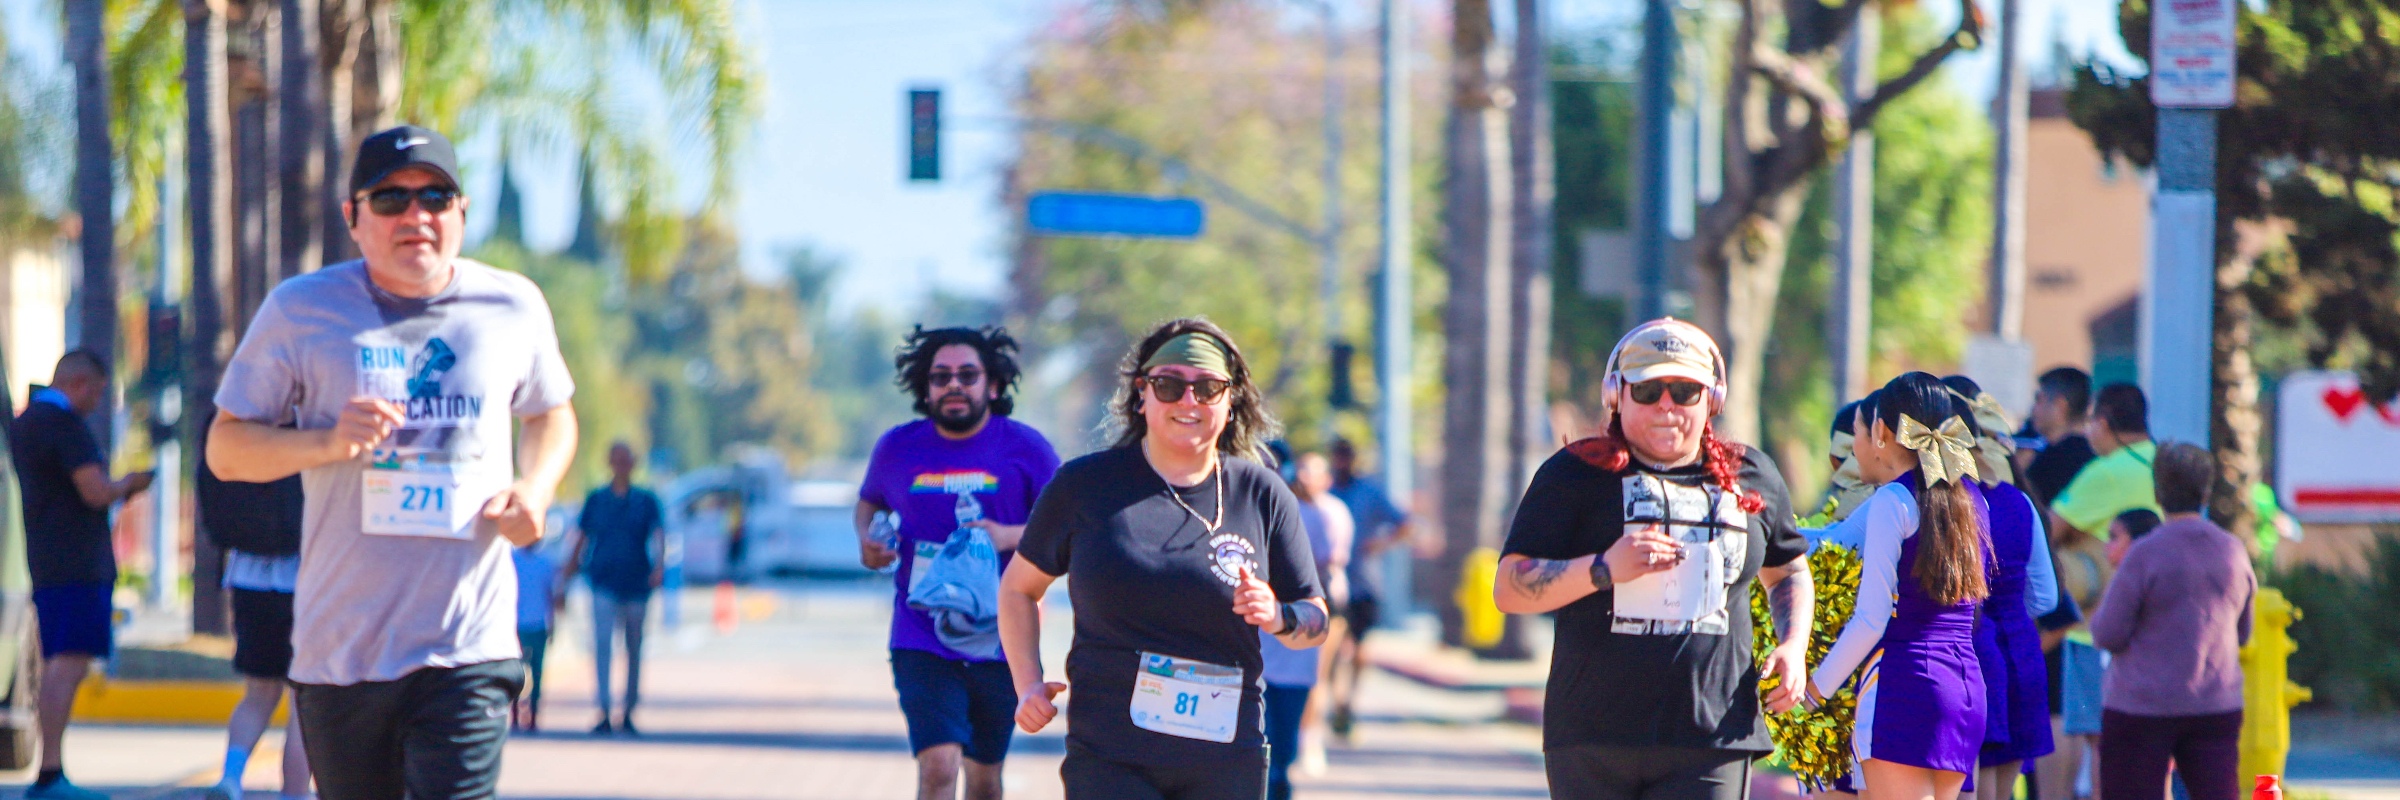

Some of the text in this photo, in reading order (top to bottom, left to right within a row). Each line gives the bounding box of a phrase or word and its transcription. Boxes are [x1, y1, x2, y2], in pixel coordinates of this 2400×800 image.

[361, 346, 405, 369] RUN
[400, 485, 444, 511] 271
[1174, 692, 1199, 716] 81
